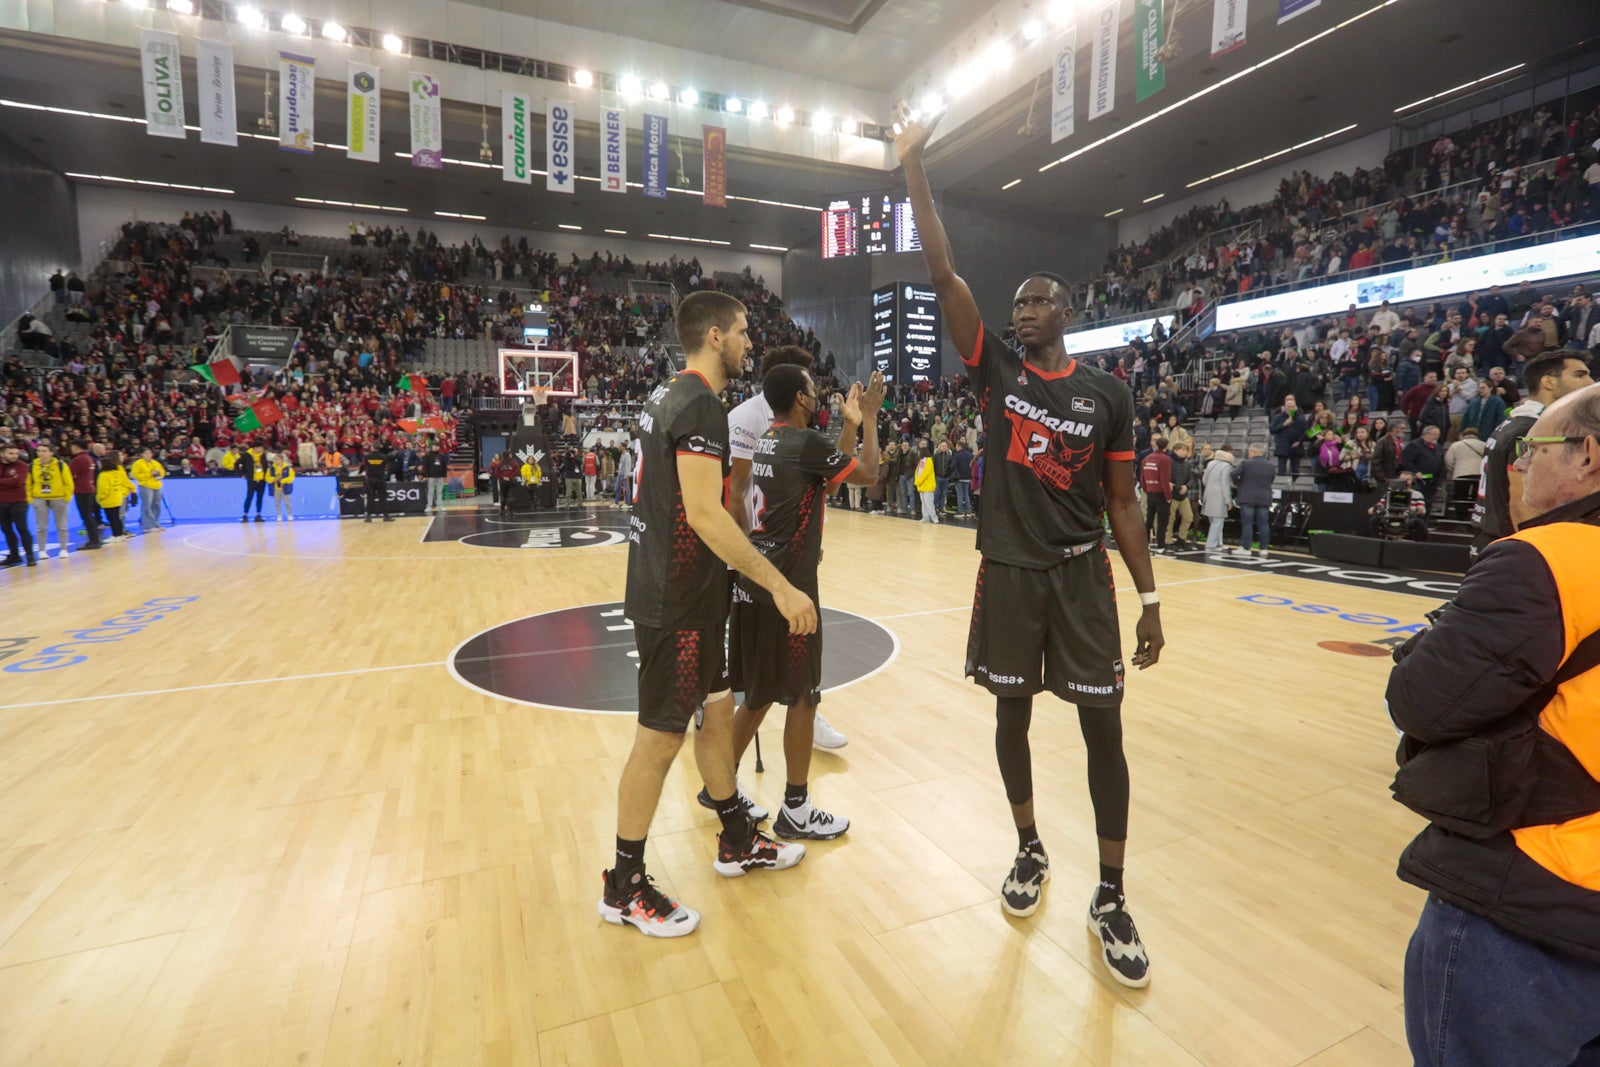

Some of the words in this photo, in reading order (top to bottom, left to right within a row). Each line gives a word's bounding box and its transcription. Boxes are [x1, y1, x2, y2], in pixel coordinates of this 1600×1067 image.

[154, 56, 173, 113] OLIVA
[287, 64, 300, 133] aeroprint
[369, 97, 377, 143] cidesur
[648, 116, 660, 155] Motor
[607, 111, 620, 173] BERNER
[648, 157, 659, 187] Mica
[386, 488, 420, 501] esa
[1076, 684, 1114, 694] BERNER
